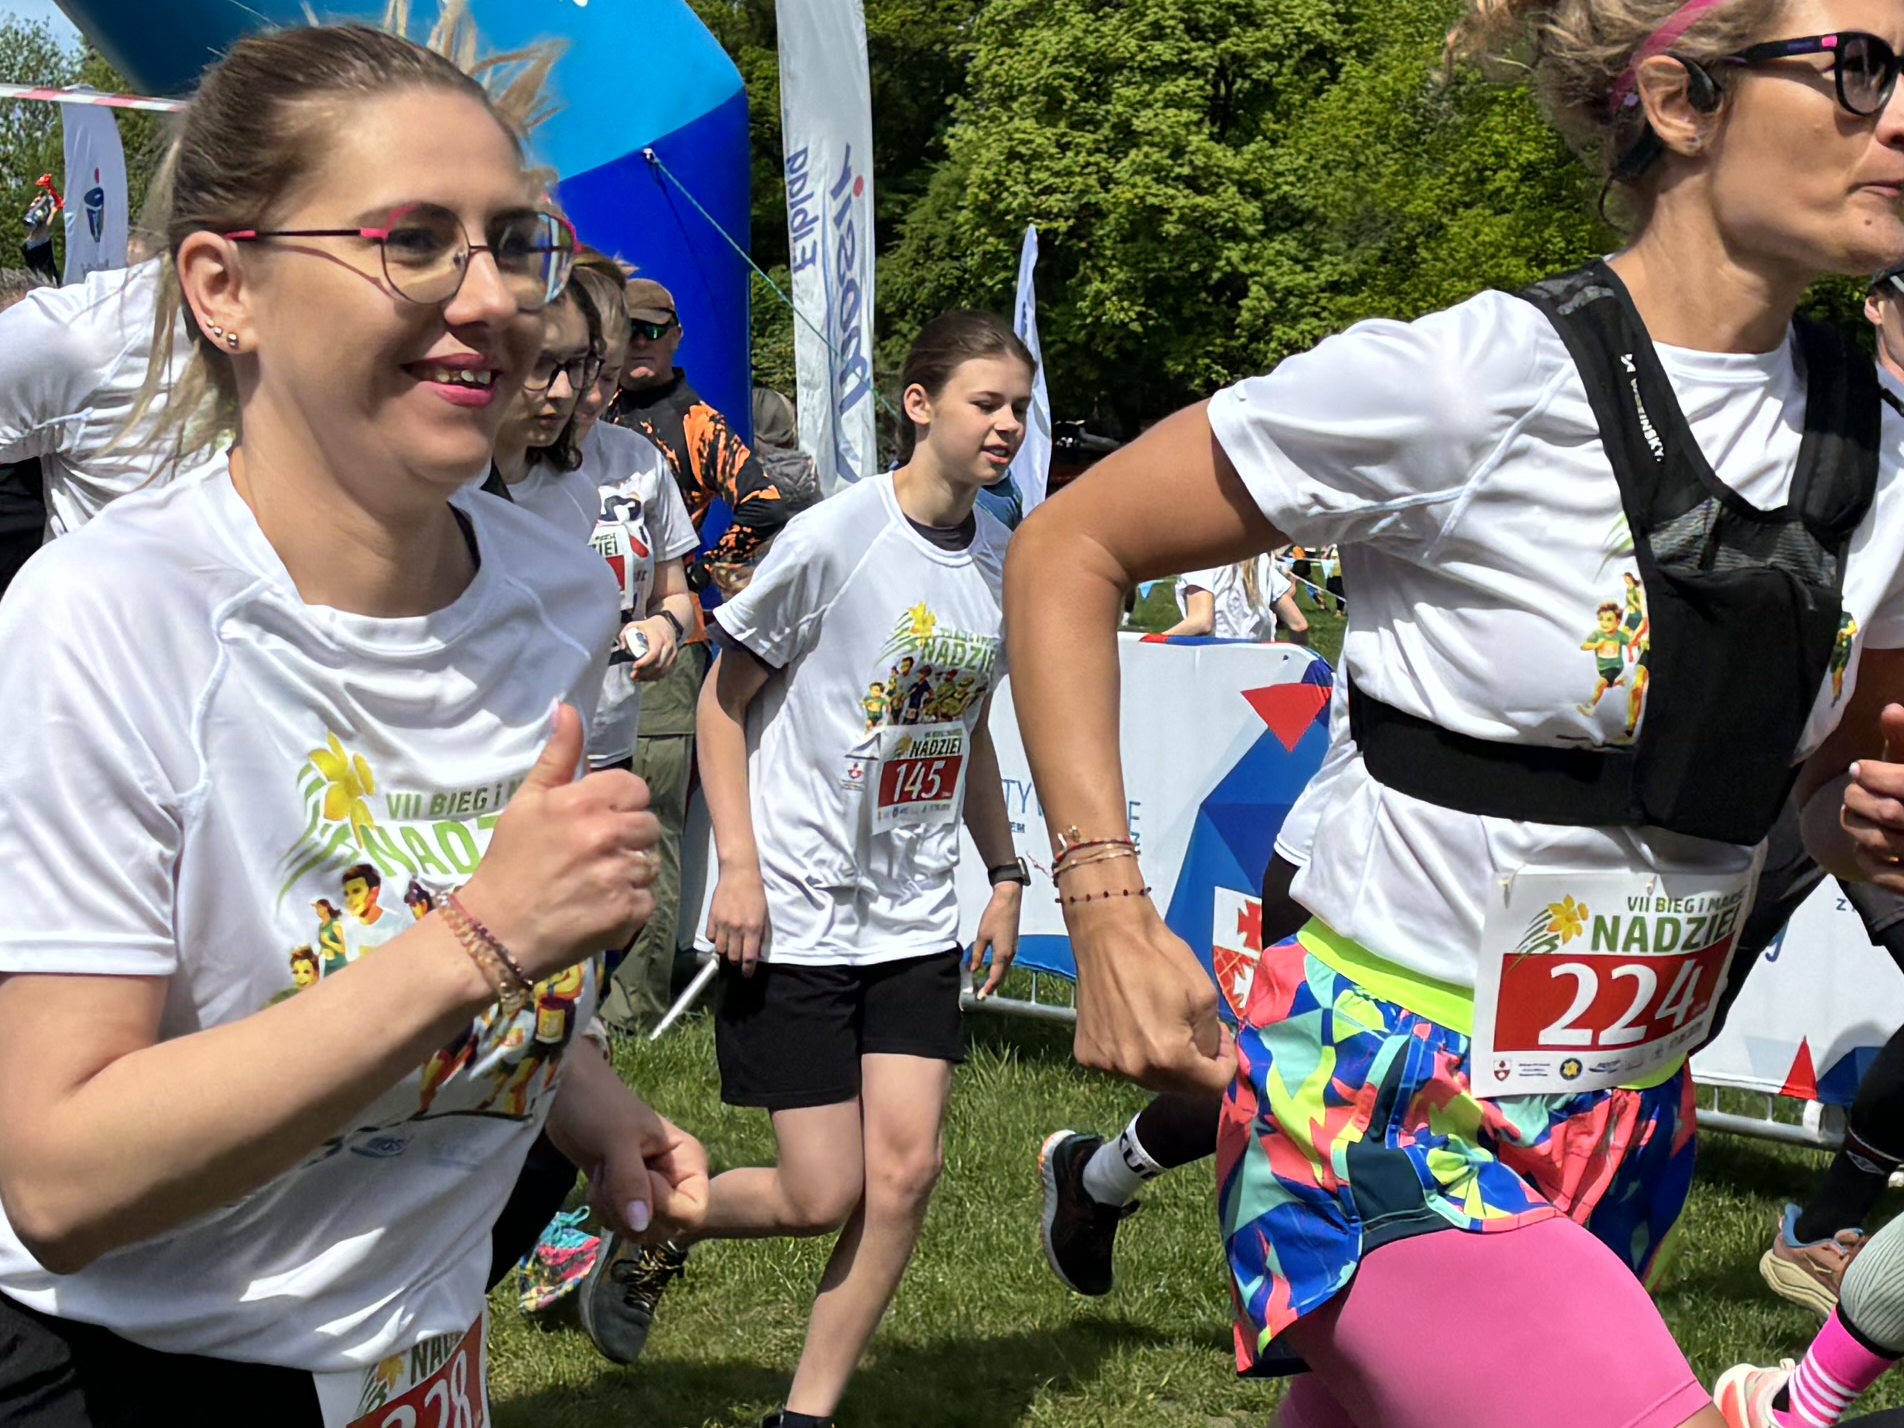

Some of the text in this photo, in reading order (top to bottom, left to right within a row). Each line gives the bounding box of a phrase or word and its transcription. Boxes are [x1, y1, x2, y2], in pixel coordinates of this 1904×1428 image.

[909, 737, 962, 759] NADZIEI
[893, 759, 947, 803] 145
[386, 792, 421, 820] VII
[429, 788, 488, 817] BIEG
[1627, 896, 1651, 913] VII
[1655, 896, 1694, 913] BIEG
[1590, 901, 1742, 953] NADZIEI
[1538, 958, 1702, 1047] 224
